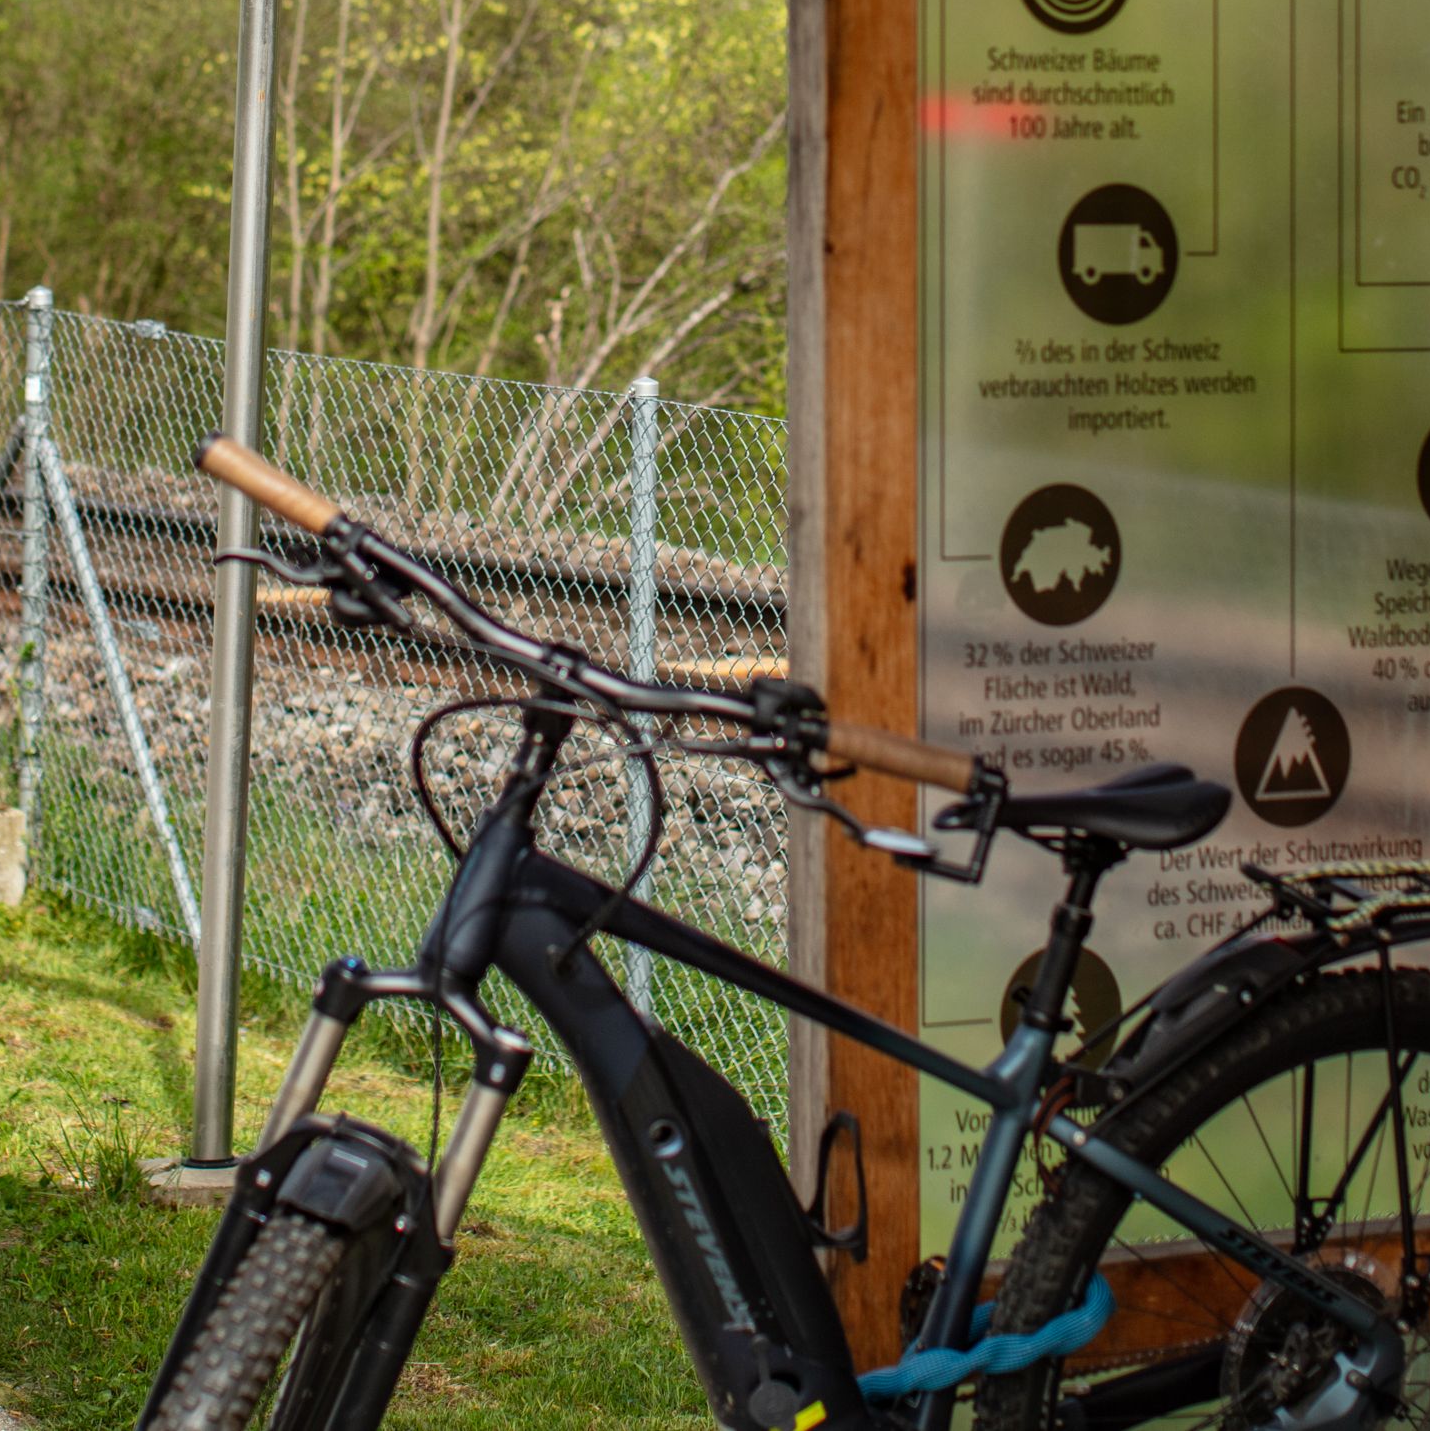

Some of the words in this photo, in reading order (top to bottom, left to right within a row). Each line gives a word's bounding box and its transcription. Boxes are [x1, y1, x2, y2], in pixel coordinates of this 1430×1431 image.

[987, 46, 1087, 71] Schweizer
[1093, 47, 1161, 72] Bäume
[972, 80, 1015, 105] sind
[1019, 80, 1176, 106] durchschnittlich
[1009, 115, 1047, 139] 100
[1052, 114, 1104, 139] Jahre
[1109, 115, 1141, 139] alt.
[1396, 101, 1425, 124] Ein
[1040, 339, 1075, 363] des
[1080, 339, 1100, 362] in
[1105, 338, 1138, 363] der
[1142, 337, 1222, 362] Schweiz
[979, 373, 1109, 398] verbrauchten
[1115, 372, 1178, 397] Holzes
[1184, 370, 1257, 394] werden
[1068, 406, 1171, 435] importiert.
[1019, 640, 1051, 665] der
[1057, 637, 1157, 664] Schweizer
[984, 674, 1047, 701] Fläche
[1053, 673, 1078, 697] ist
[1080, 670, 1137, 697] Wald,
[959, 712, 985, 736] im
[989, 708, 1064, 735] Zürcher
[1071, 703, 1161, 730] Oberland
[1012, 750, 1034, 769] es
[1040, 744, 1095, 773] sogar
[1160, 847, 1193, 871] Der
[1197, 845, 1243, 869] Wert
[1250, 842, 1281, 866] der
[1285, 835, 1423, 865] Schutzwirkung
[1148, 882, 1180, 907] des
[1154, 920, 1180, 940] ca.
[1186, 912, 1225, 937] CHF
[1231, 913, 1244, 933] 4
[928, 1144, 952, 1171] 1.2
